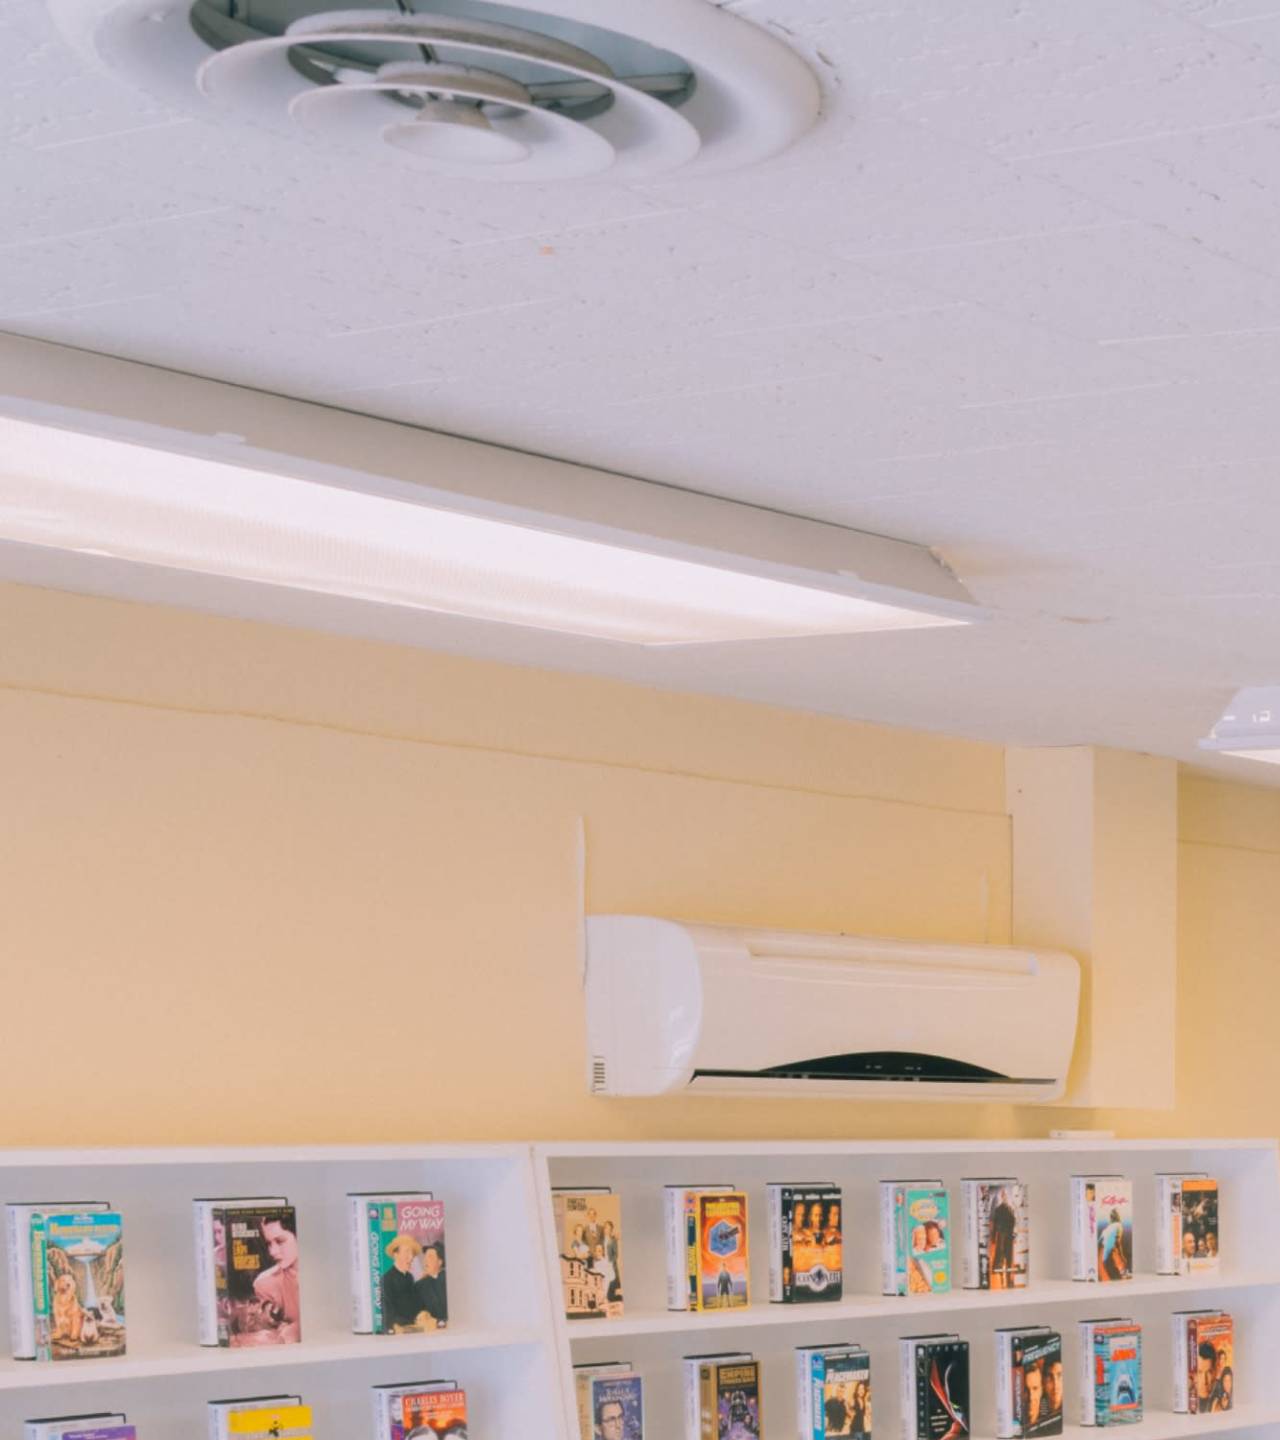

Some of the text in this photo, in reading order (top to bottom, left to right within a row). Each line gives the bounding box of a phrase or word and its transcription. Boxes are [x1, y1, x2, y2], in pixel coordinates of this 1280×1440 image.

[402, 1206, 440, 1217] GOING
[400, 1218, 444, 1230] MY WAY
